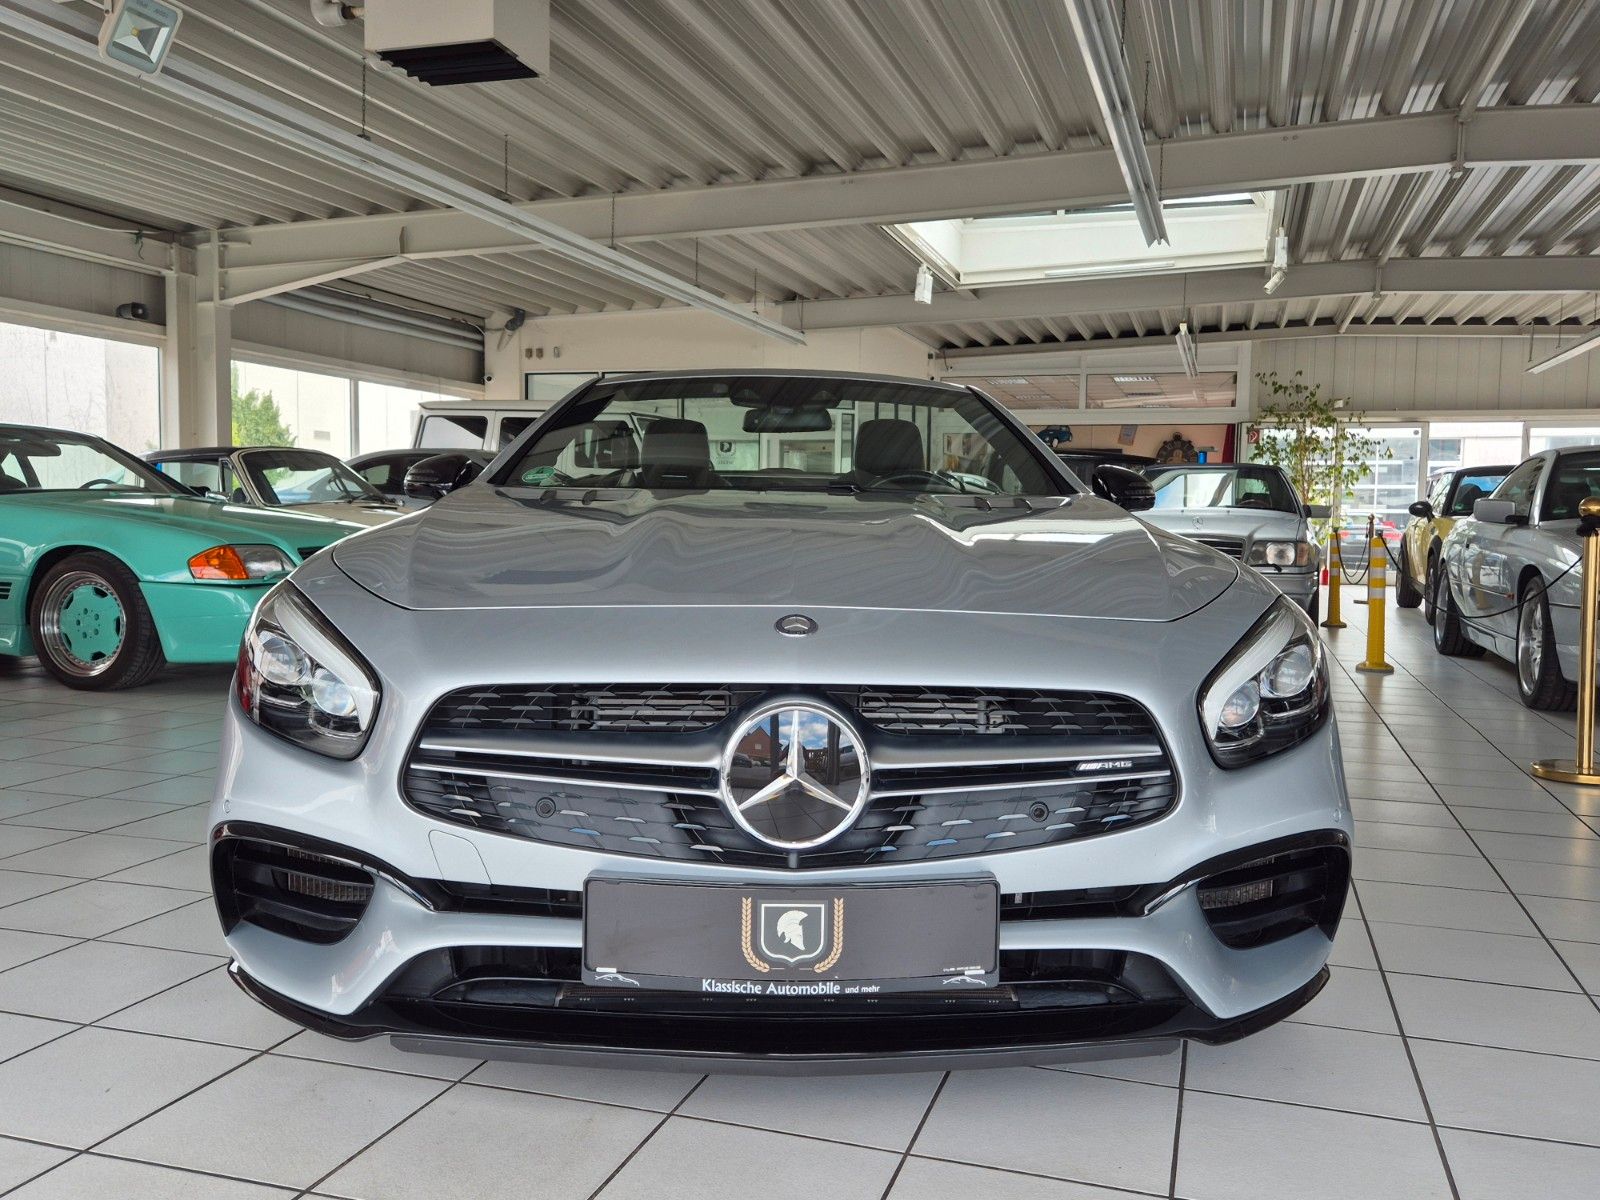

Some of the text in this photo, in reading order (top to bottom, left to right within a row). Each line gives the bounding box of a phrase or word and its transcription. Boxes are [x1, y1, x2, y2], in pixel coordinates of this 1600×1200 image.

[702, 979, 881, 995] Klassische Automobile und mehr
